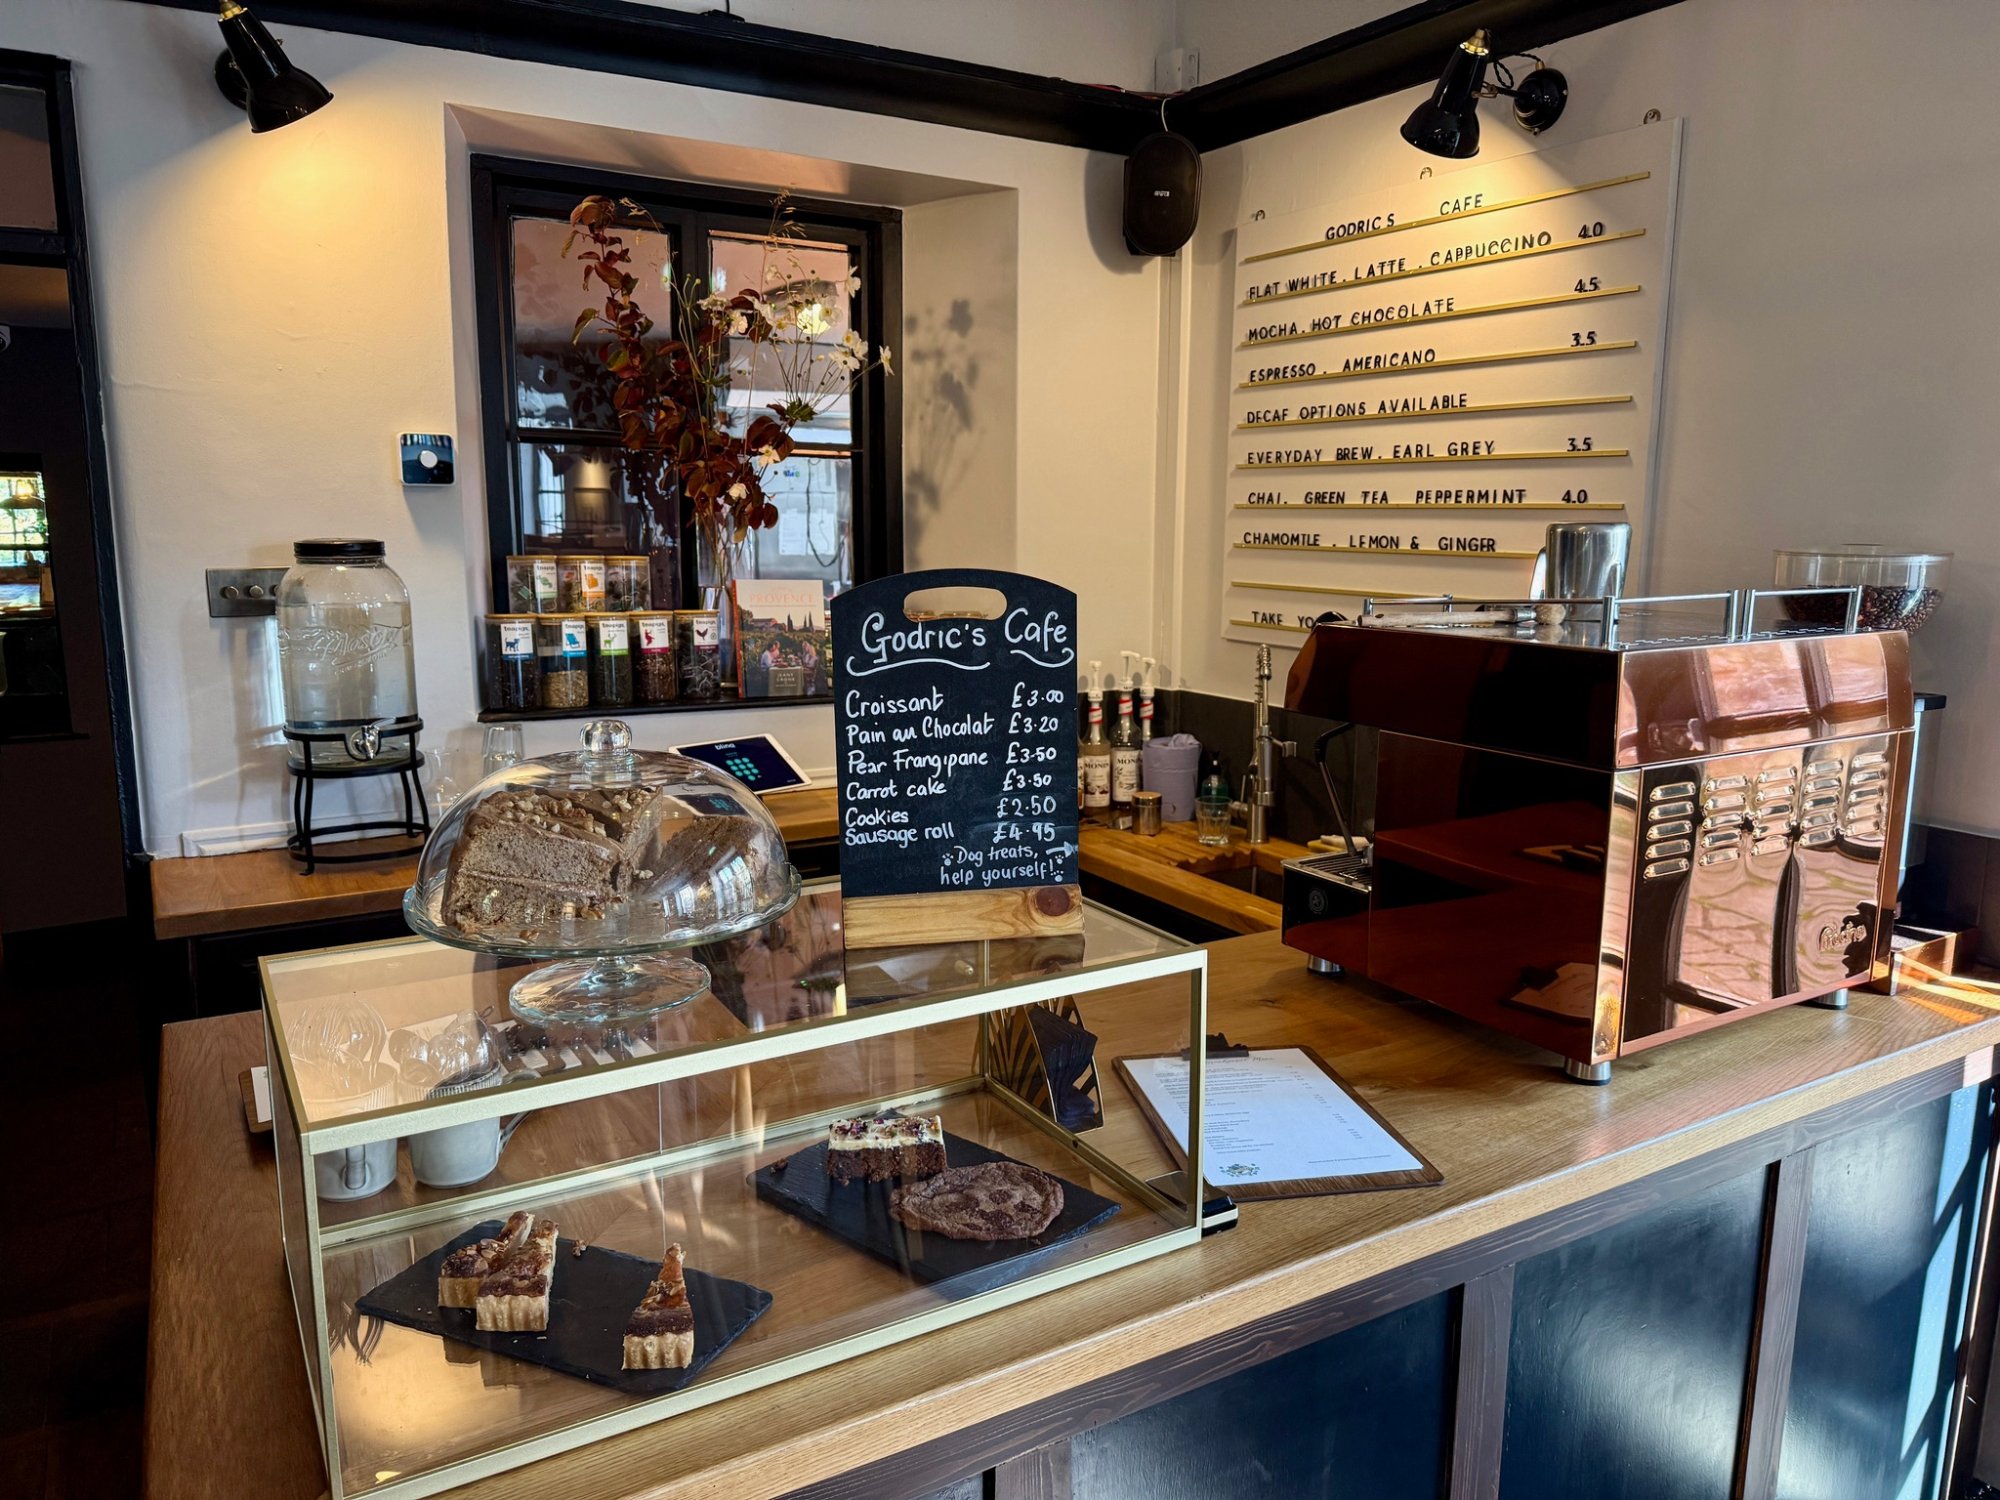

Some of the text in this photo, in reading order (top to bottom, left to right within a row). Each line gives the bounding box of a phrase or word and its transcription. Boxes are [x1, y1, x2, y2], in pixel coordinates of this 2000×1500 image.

[1440, 193, 1483, 216] CAFE
[1249, 282, 1280, 299] FLAT
[1430, 231, 1552, 266] CAPPUCCINO
[1312, 315, 1342, 331] HOT
[1351, 297, 1454, 325] CHOCOLATE
[1574, 276, 1598, 293] 4.5
[1250, 363, 1316, 382] ESPRESSO
[1343, 348, 1435, 372] AMERICANO
[1571, 331, 1596, 347] 3.5
[1300, 402, 1366, 419] OPTIONS
[1378, 393, 1467, 414] AVAILABLE
[1248, 449, 1322, 464] EVERYDAY
[1393, 443, 1434, 459] EARL
[1448, 440, 1494, 457] GREY
[1567, 437, 1592, 452] 3.5
[1304, 491, 1345, 504] GREEN
[1361, 490, 1388, 504] TEA
[1415, 489, 1526, 504] PEPPERMINT
[1562, 489, 1588, 504] 4.0
[1410, 536, 1419, 550] &
[861, 608, 1068, 664] Godric's Cafe
[1297, 616, 1315, 629] YO
[845, 682, 1064, 718] Croissant £3.00
[845, 712, 1058, 746] Pain au Chocolat £3.20
[847, 749, 887, 774] Pear
[892, 748, 988, 778] Frangipane
[846, 768, 1051, 801] Carrot cake £3.50
[845, 795, 1056, 827] Cookies £2.50
[845, 821, 1056, 848] Sausage roll £4.95
[953, 844, 1039, 867] Dog treats,
[940, 858, 1054, 887] help yourself!
